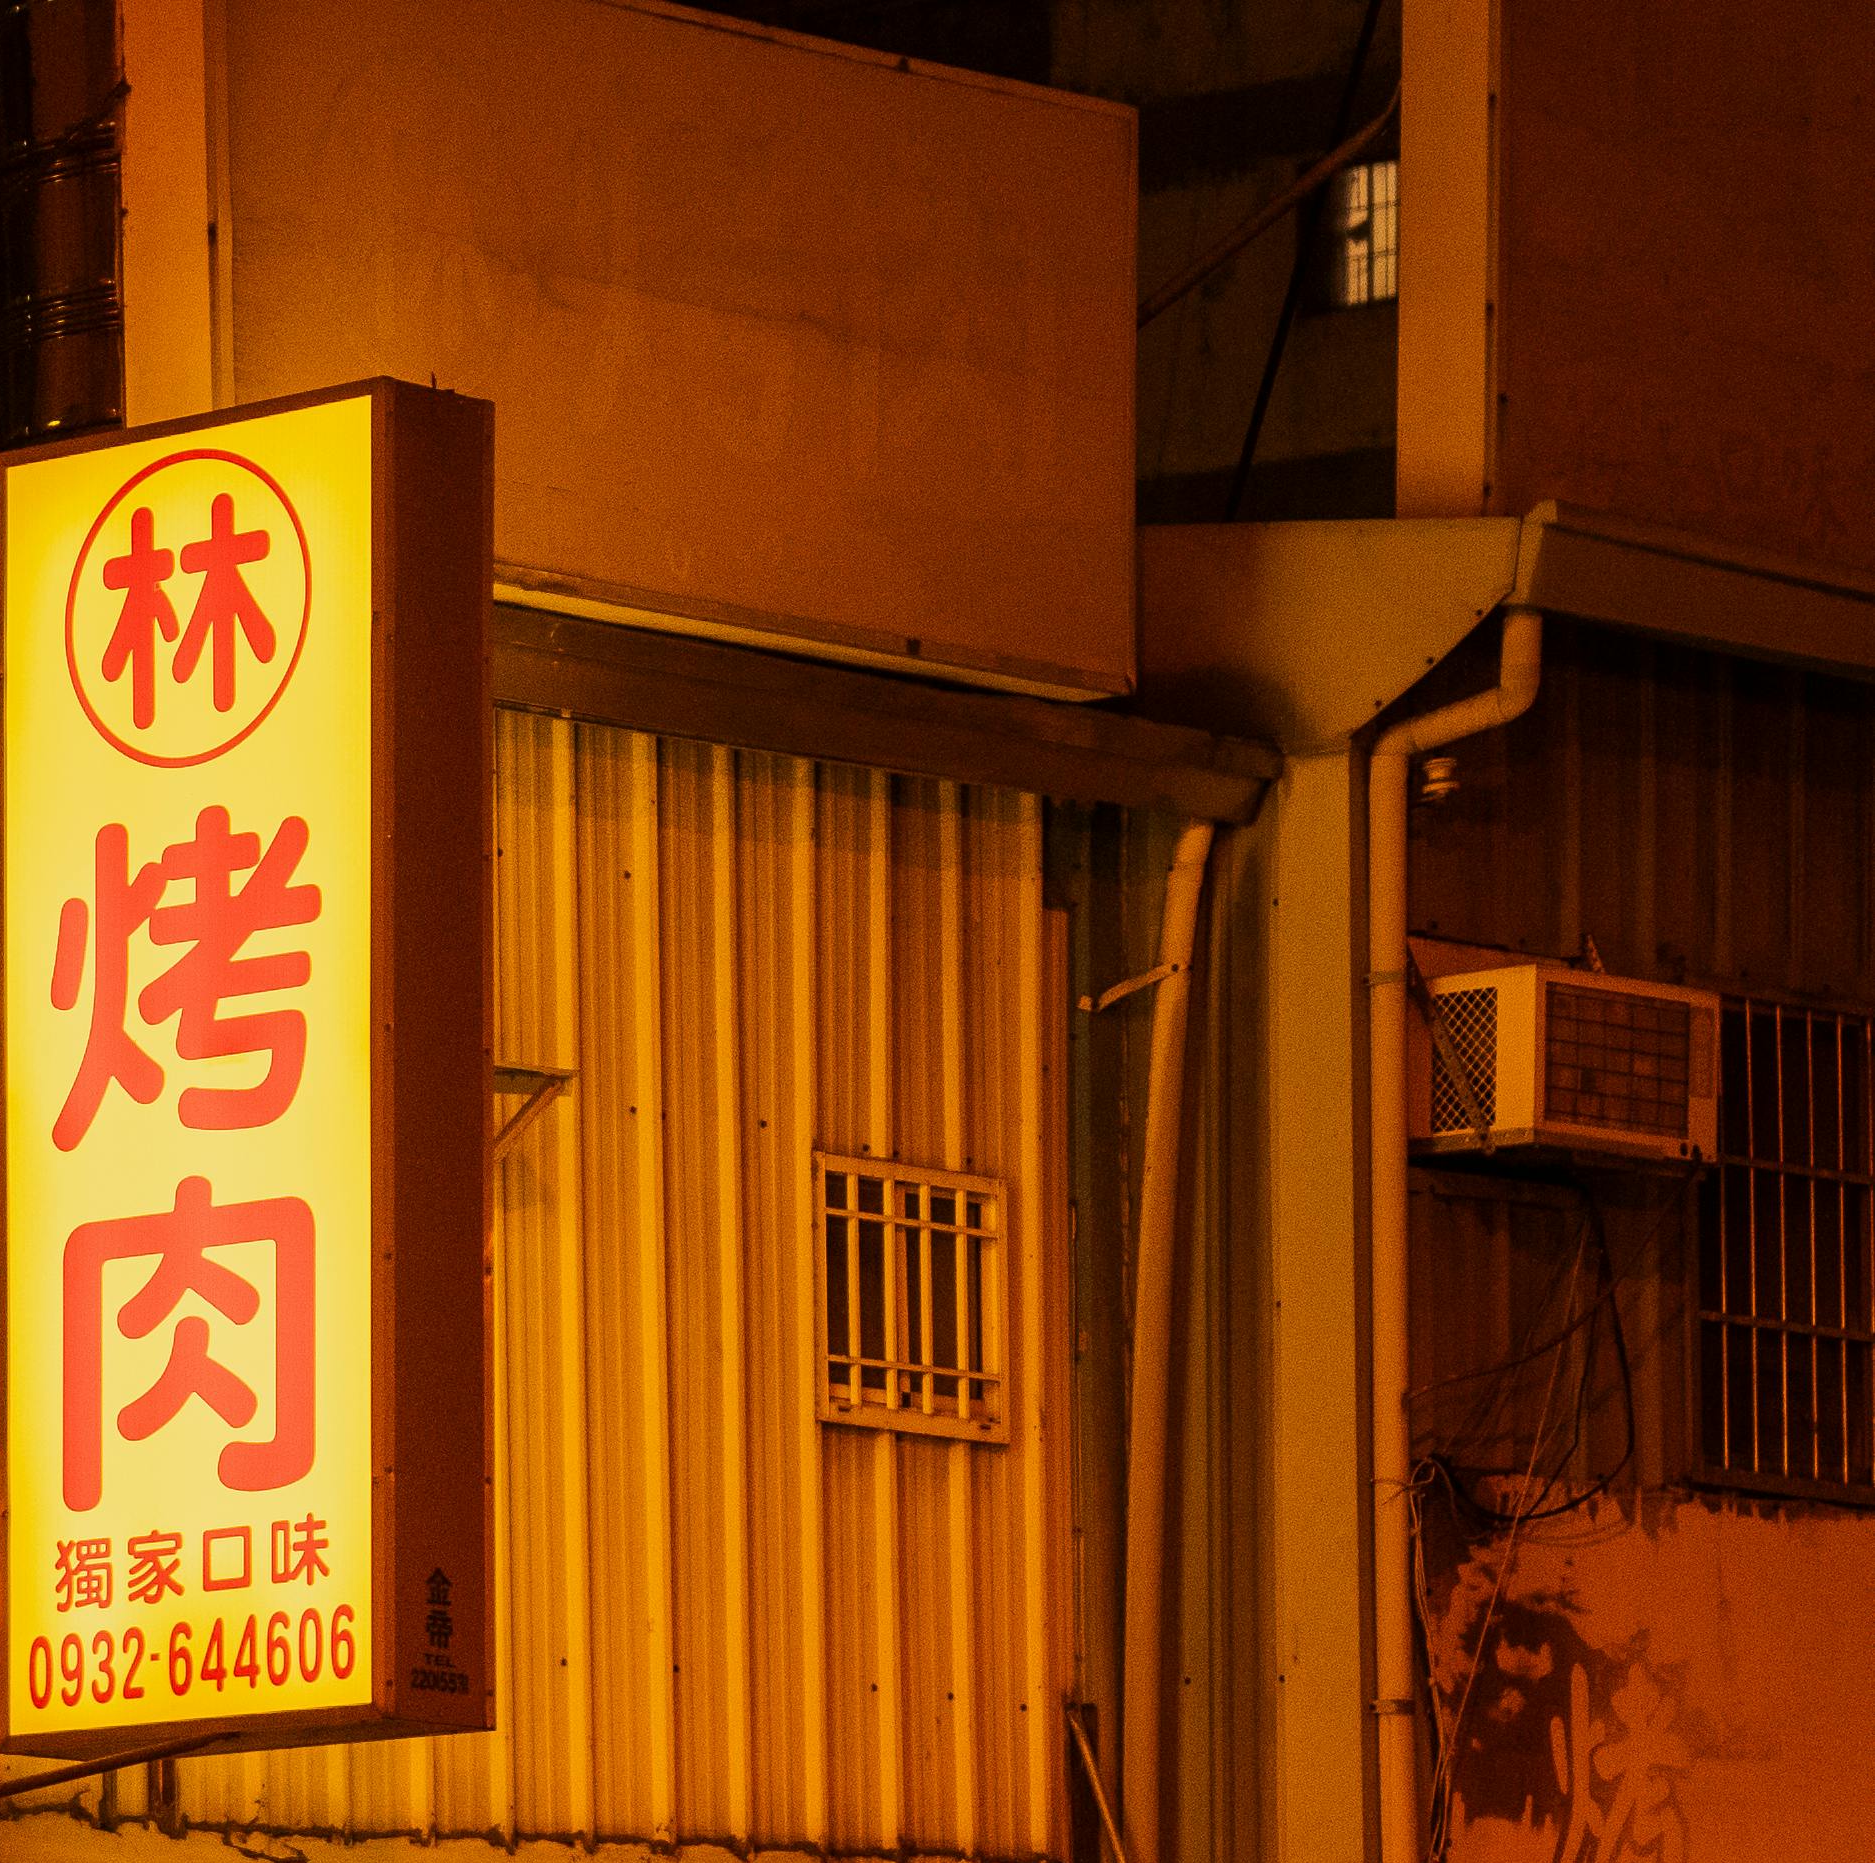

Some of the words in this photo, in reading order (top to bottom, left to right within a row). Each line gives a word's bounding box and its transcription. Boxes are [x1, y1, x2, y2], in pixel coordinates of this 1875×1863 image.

[100, 491, 276, 731] 林
[49, 804, 323, 1513] 烤肉
[53, 1511, 331, 1616] 獨家口味
[27, 1601, 357, 1711] 0932-644606
